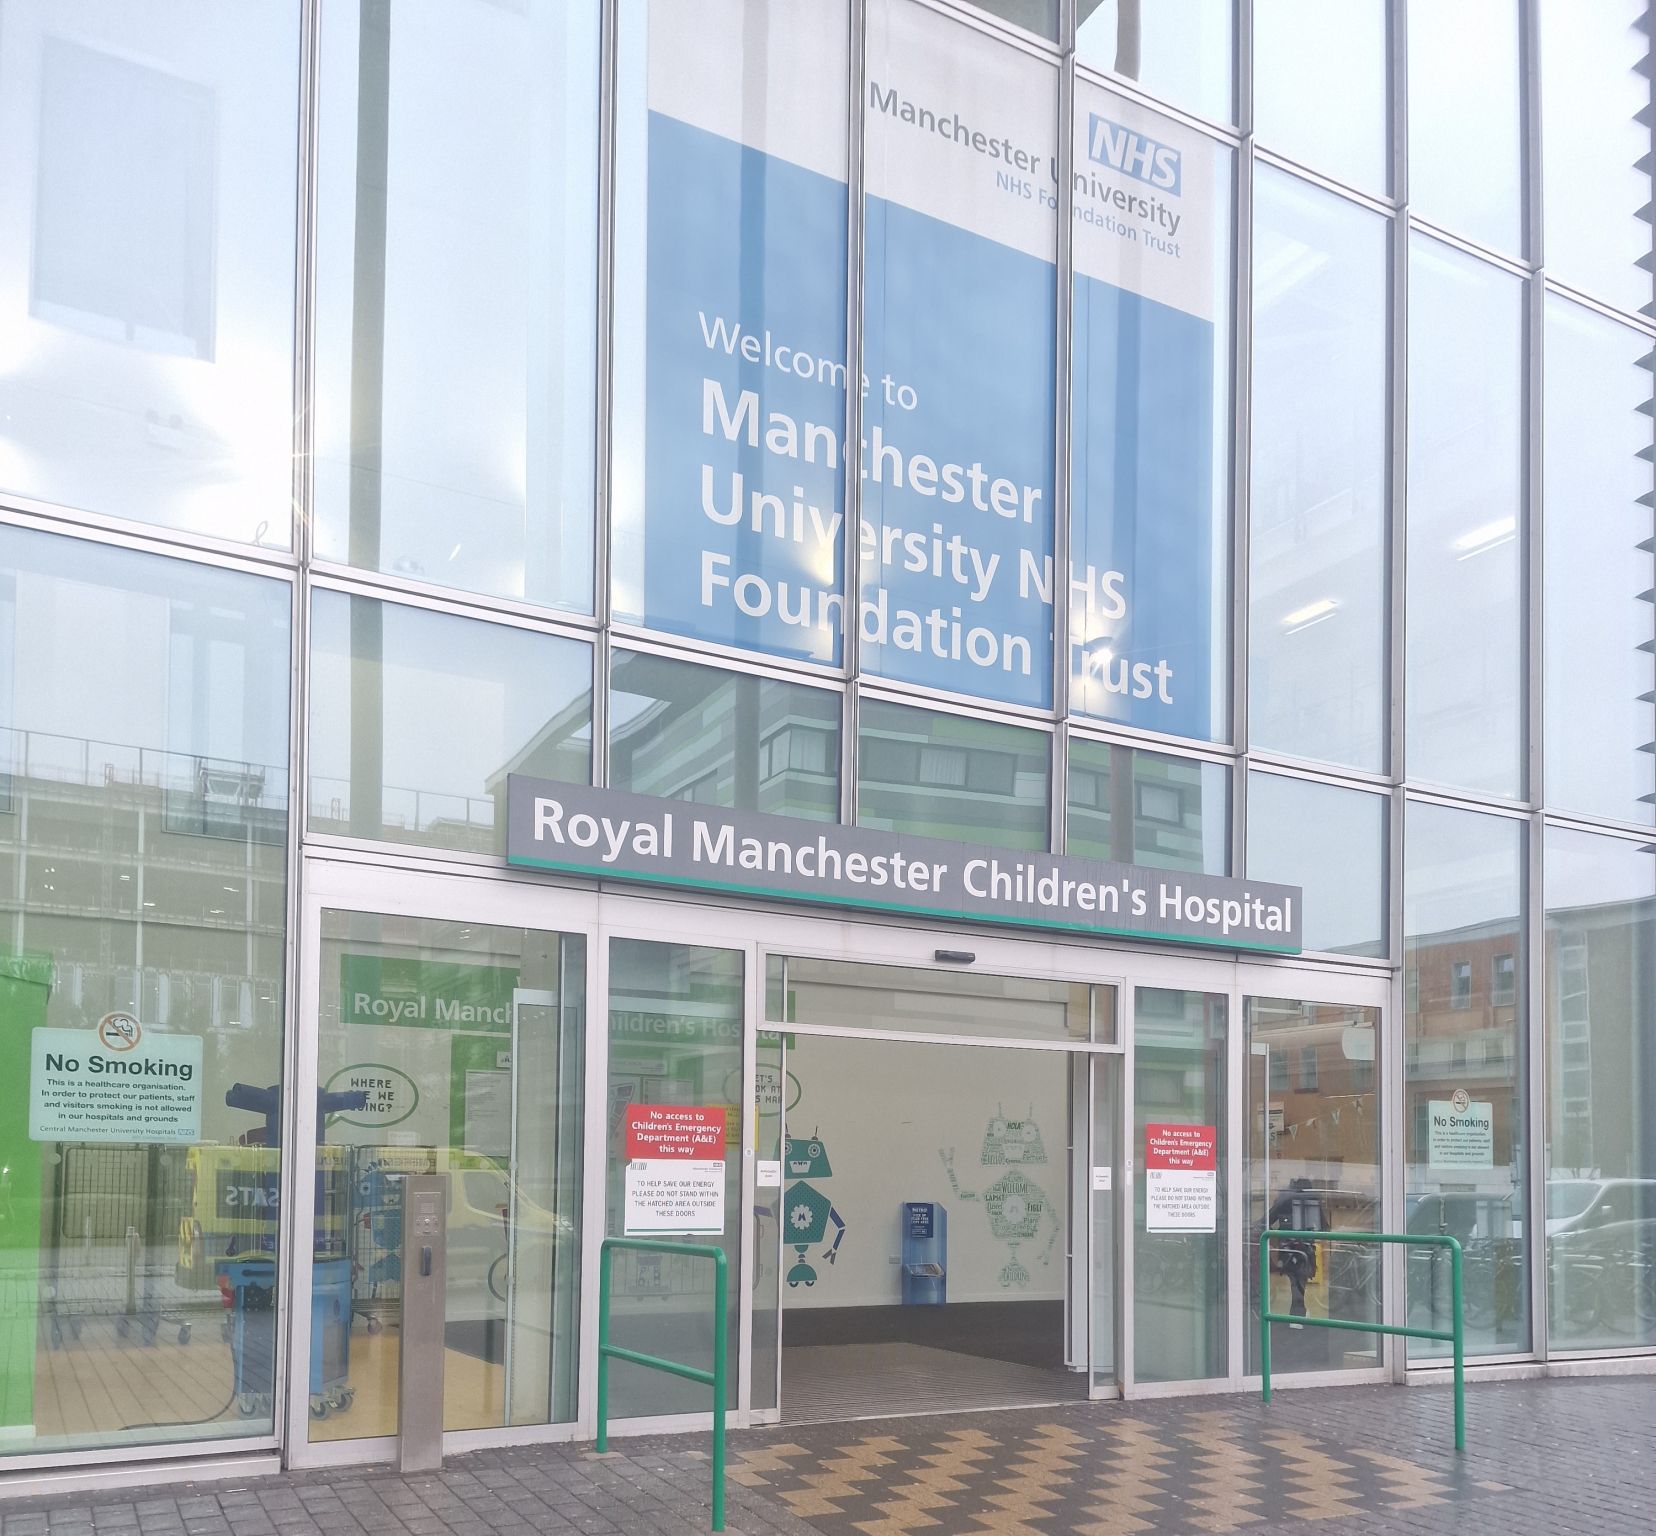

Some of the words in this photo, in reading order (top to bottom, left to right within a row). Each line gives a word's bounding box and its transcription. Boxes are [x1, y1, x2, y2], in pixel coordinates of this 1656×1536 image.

[870, 81, 1040, 174] Manchester
[1091, 121, 1176, 188] NHS
[997, 171, 1032, 199] NHS
[1039, 188, 1136, 241] Fondation
[1143, 230, 1181, 258] Trust
[881, 374, 917, 410] to
[702, 464, 999, 602] University
[1020, 549, 1126, 619] NHS
[701, 550, 1032, 675] Foundation
[534, 797, 672, 861] Royal
[692, 820, 947, 892] Manchester
[963, 859, 1147, 915] Children's
[1160, 883, 1291, 934] Hospital
[354, 992, 425, 1022] Royal
[608, 1012, 696, 1036] hildren's
[45, 1053, 80, 1072] No
[88, 1055, 193, 1081] Smoking
[351, 1078, 392, 1088] WHERE
[756, 1074, 773, 1083] ET'S
[85, 1080, 130, 1089] healthcare
[132, 1083, 186, 1091] organisation.
[52, 1090, 76, 1098] order
[89, 1092, 121, 1100] protect
[138, 1093, 175, 1102] patients,
[378, 1091, 395, 1101] WE
[97, 1103, 133, 1112] smoking
[85, 1113, 124, 1122] hospitals
[144, 1115, 179, 1123] grounds
[650, 1111, 663, 1119] No
[695, 1112, 705, 1120] to
[631, 1121, 672, 1131] Children's
[675, 1123, 721, 1134] Emergency
[1434, 1116, 1447, 1127] No
[1450, 1116, 1489, 1130] Smoking
[110, 1127, 144, 1135] University
[145, 1128, 176, 1136] Hospitals
[637, 1133, 689, 1143] Department
[692, 1135, 716, 1144] (A&E)
[1150, 1138, 1178, 1146] Children's
[1180, 1139, 1212, 1149] Emergency
[659, 1145, 675, 1153] this
[678, 1146, 694, 1155] way
[1153, 1147, 1190, 1156] Department
[1182, 1158, 1194, 1166] way
[1002, 1182, 1028, 1194] WELCOME
